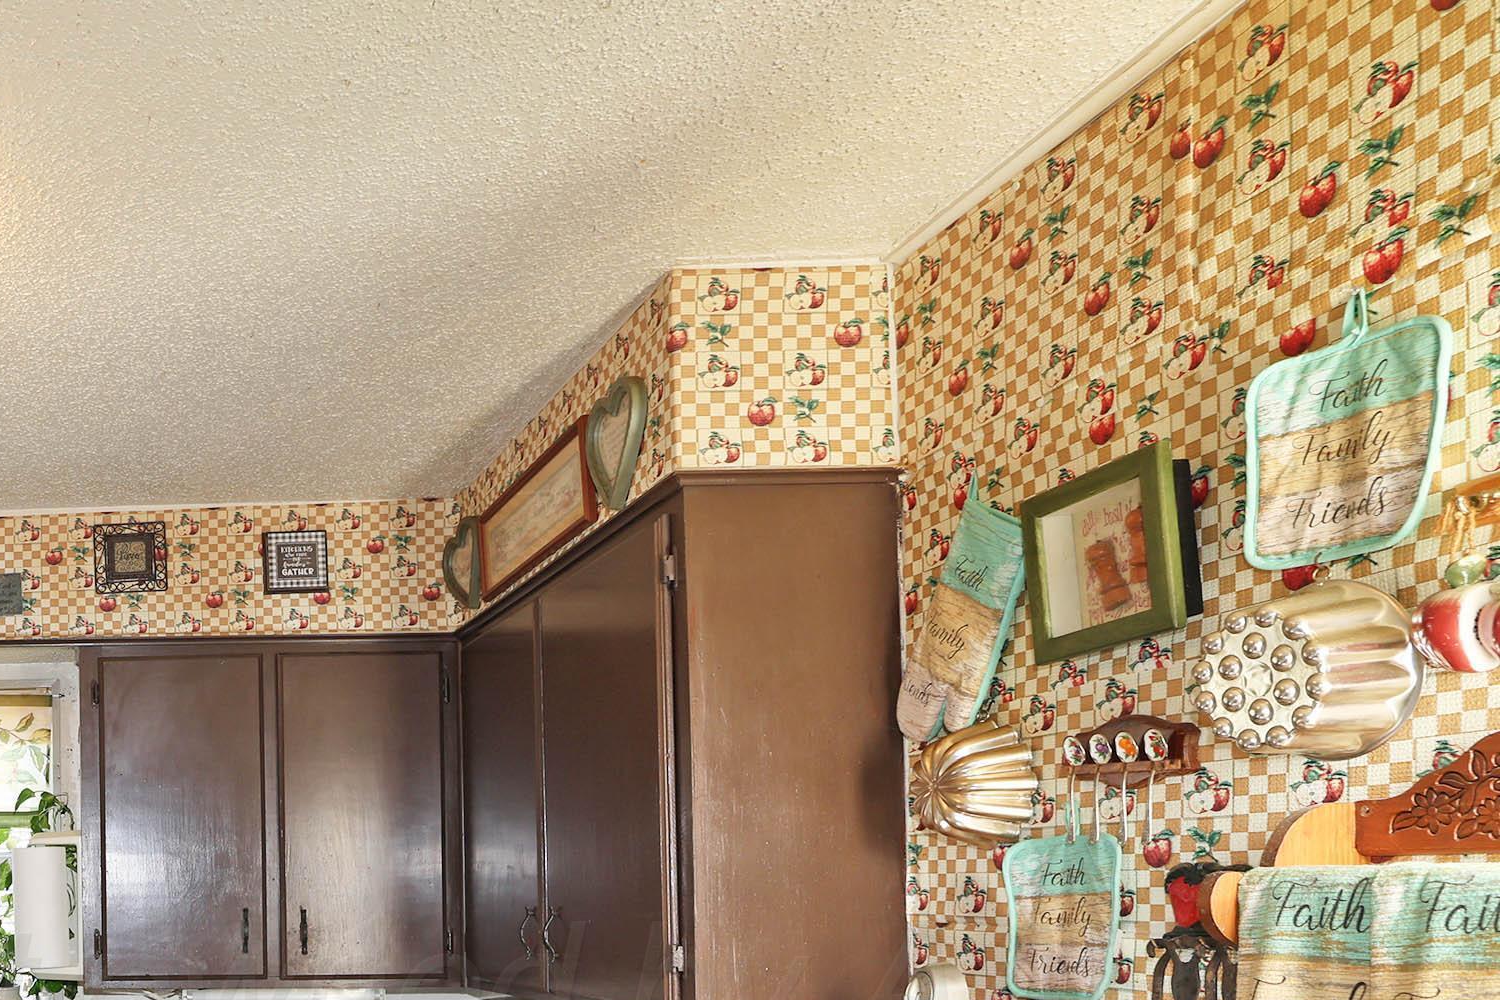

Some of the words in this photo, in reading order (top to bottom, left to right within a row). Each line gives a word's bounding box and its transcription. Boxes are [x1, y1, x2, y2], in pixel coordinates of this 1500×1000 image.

[1308, 358, 1388, 412] Faith
[1292, 410, 1395, 465] Family
[1286, 475, 1390, 529] Friends
[281, 568, 315, 577] GATHER
[955, 554, 989, 592] Faith
[926, 611, 969, 660] Family
[1041, 857, 1086, 887] Faith
[1030, 896, 1091, 938] Family
[1272, 876, 1371, 934] Faith
[1419, 874, 1500, 935] Fait
[1026, 946, 1090, 978] Friends
